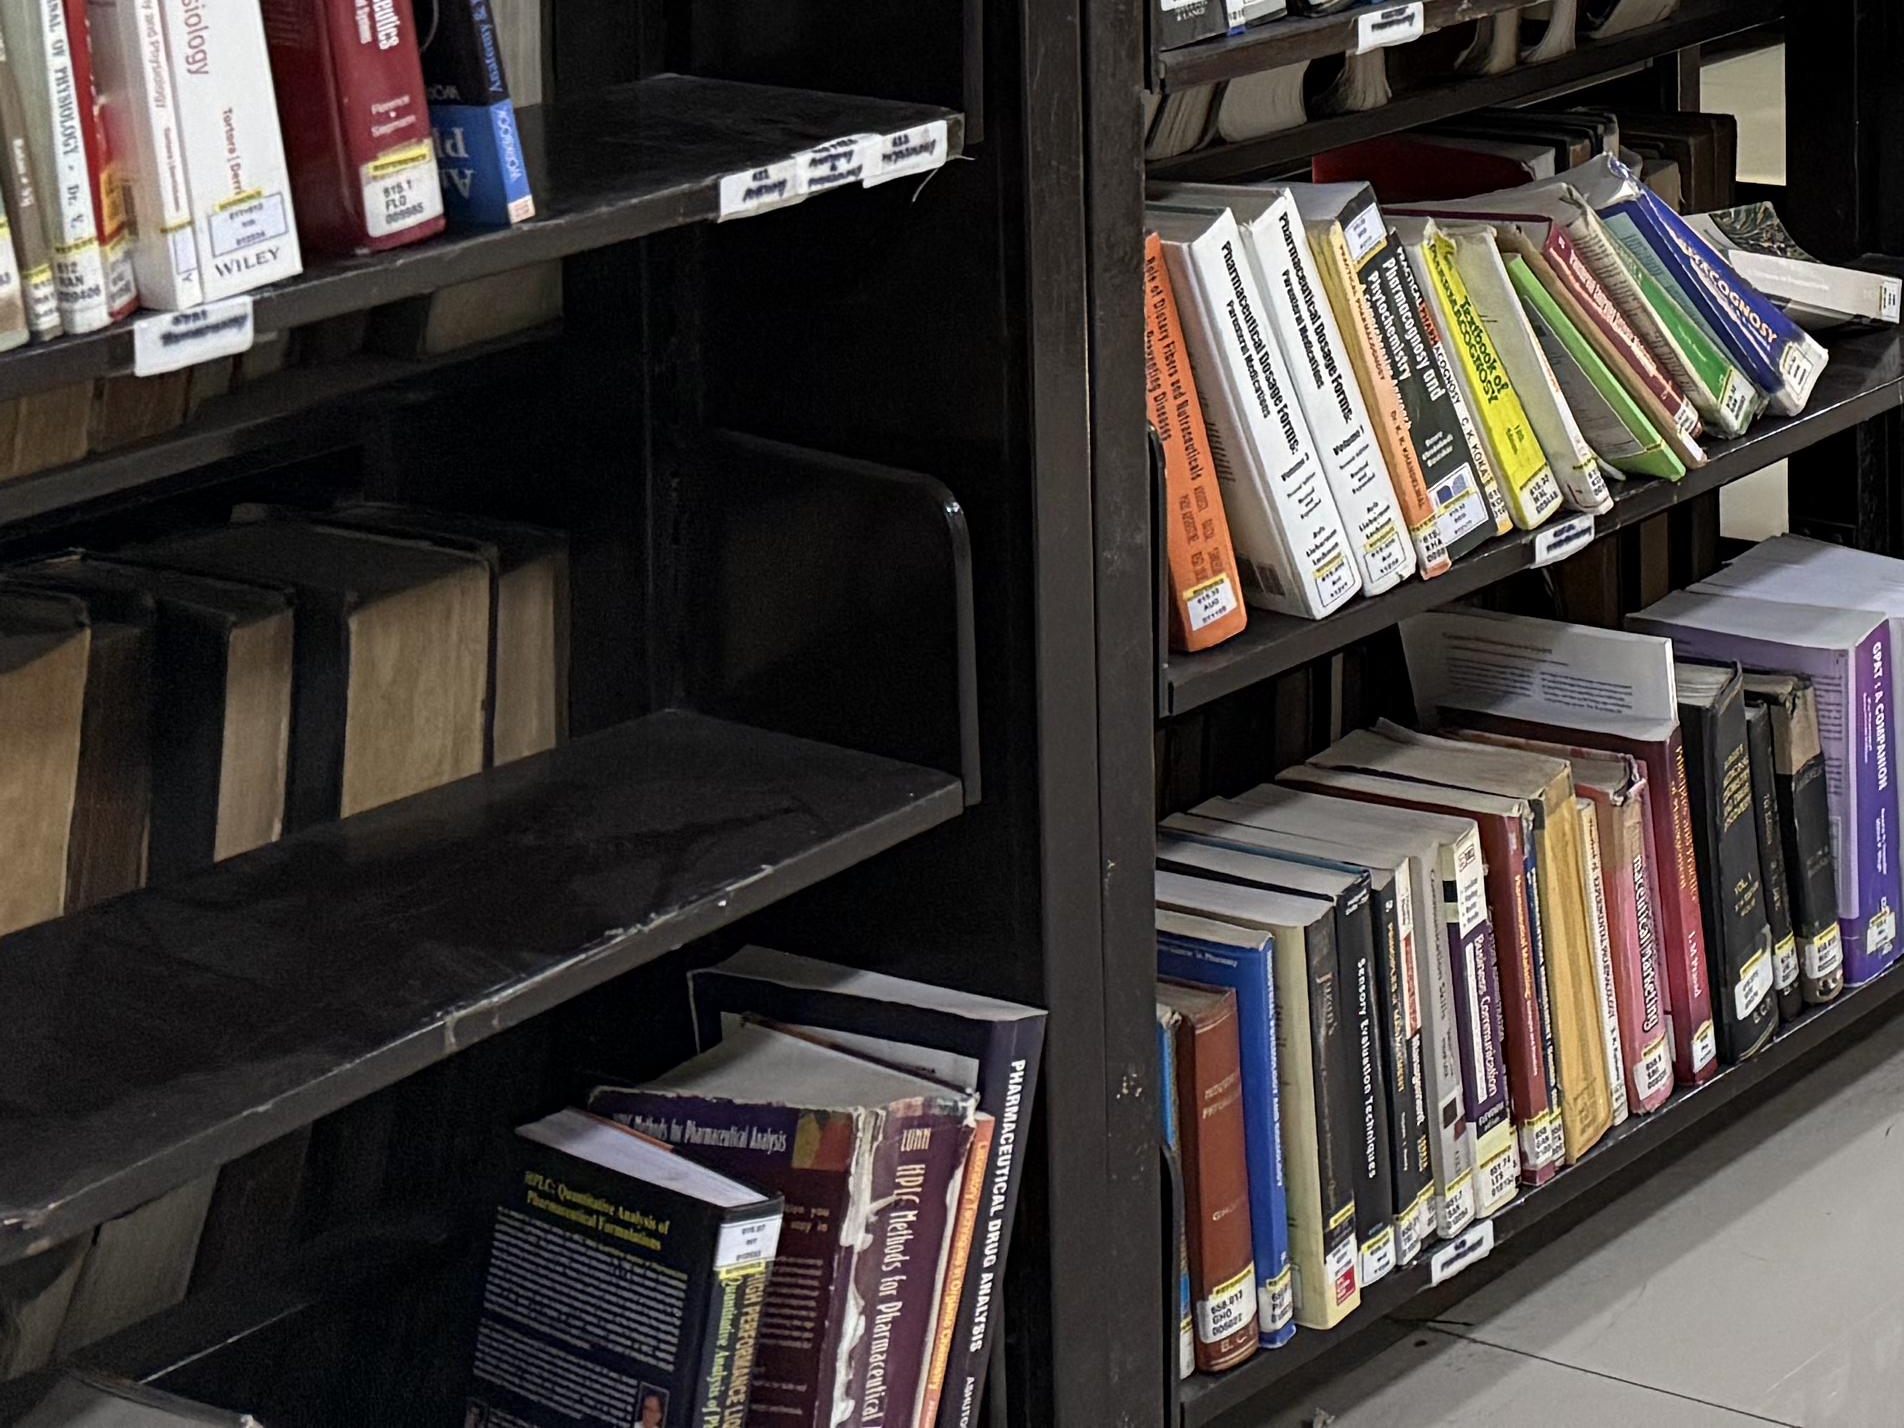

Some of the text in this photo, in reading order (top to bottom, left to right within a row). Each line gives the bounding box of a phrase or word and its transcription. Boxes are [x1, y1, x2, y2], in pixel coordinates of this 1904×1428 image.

[222, 106, 240, 157] Tortora
[215, 247, 281, 280] WILEY
[1278, 212, 1353, 424] Pharmaceutical Dosage Forms:
[1367, 270, 1411, 382] Phytochemistry
[1396, 246, 1461, 404] PRACTICAL PHARMACOGNOSY
[1221, 243, 1299, 454] Pharmaceutical Dosage Forms:
[1382, 256, 1447, 402] Pharmacognosy and
[1459, 295, 1497, 375] Textbook
[1872, 640, 1888, 792] GPAT COMPANION
[1356, 958, 1377, 1180] Sensory Evaluation Techniques
[1481, 993, 1498, 1098] Communication
[685, 1121, 787, 1154] Pharmaceutical Analysis
[900, 1128, 931, 1151] LUNN
[617, 1205, 654, 1232] Analysis
[970, 1059, 1027, 1354] PHARMACEUTICAL DRUG ANALYSIS
[860, 1164, 927, 1427] HPLC Methods for Pharmaceutical
